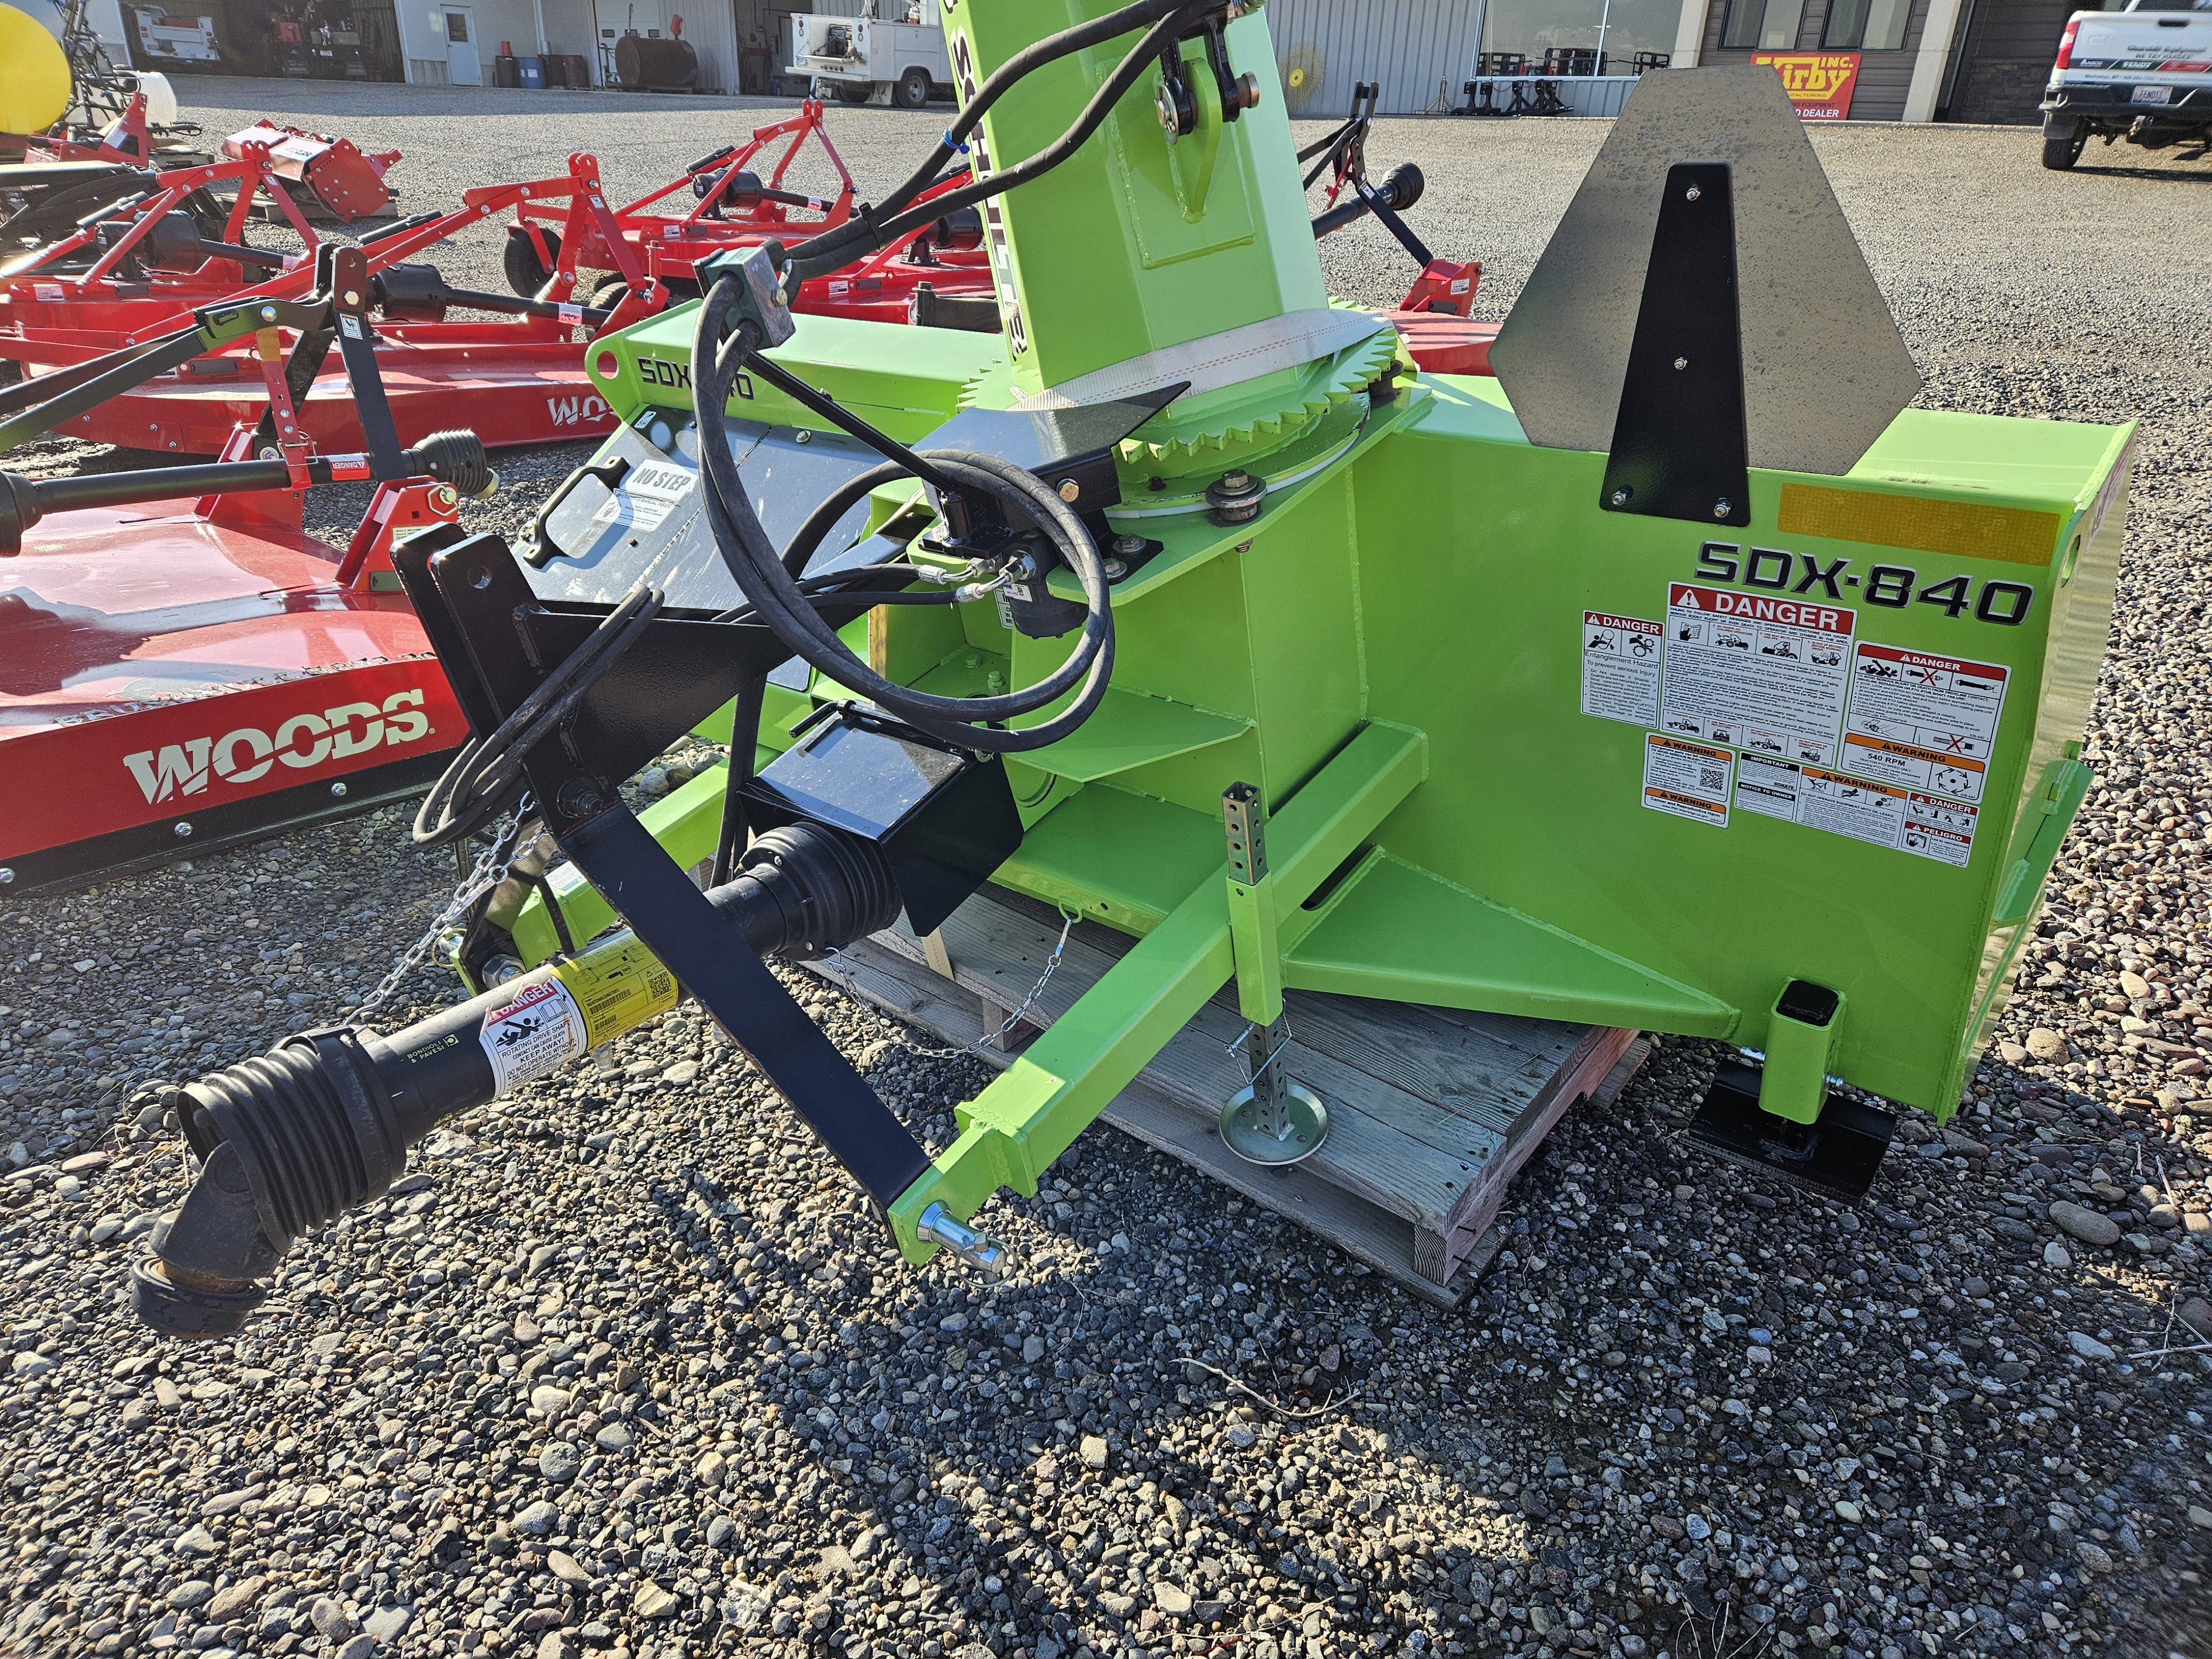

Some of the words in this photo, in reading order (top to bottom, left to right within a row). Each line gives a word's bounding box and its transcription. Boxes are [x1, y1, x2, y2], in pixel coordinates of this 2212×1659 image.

[1820, 57, 1853, 67] INC.
[1802, 109, 1839, 117] DEALER
[637, 357, 754, 400] SDX0
[633, 468, 658, 485] NO
[653, 472, 691, 491] STEP
[1694, 541, 2036, 625] SDX-840
[1715, 593, 1839, 630] DANGER
[1603, 617, 1659, 634] DANGER
[1585, 651, 1631, 665] Entanglement
[1634, 659, 1658, 669] Hazard
[1912, 656, 1960, 671] DANGER
[1595, 661, 1615, 671] prevent
[1640, 669, 1655, 677] Injury
[123, 688, 429, 805] WOODS
[1673, 743, 1716, 757] WARNING
[1892, 745, 1946, 762] WARNING
[1750, 756, 1789, 768] IMPORTANT
[1867, 753, 1882, 761] 540
[1885, 757, 1905, 766] RPM
[1834, 775, 1887, 793] WARNING
[1670, 794, 1712, 808] WARNING
[1771, 791, 1792, 799] OWNER
[1677, 803, 1706, 815] Reproductive
[1836, 801, 1859, 809] EQUIPMENT
[1929, 798, 1971, 813] DANGER
[1923, 827, 1963, 841] PELIGRO
[407, 1041, 441, 1059] BONDIOLI
[419, 1045, 445, 1060] PAVESI
[502, 1040, 533, 1058] ROTATING
[533, 1031, 551, 1043] DRIVE
[513, 1048, 531, 1060] CONTACT
[531, 1044, 540, 1052] CAN
[540, 1039, 552, 1048] CAUSE
[552, 1031, 565, 1042] DEATH
[520, 1050, 540, 1063] KEEP
[541, 1037, 565, 1053] AWAY!
[516, 1063, 526, 1073] NOT
[528, 1051, 552, 1067] OPERATE
